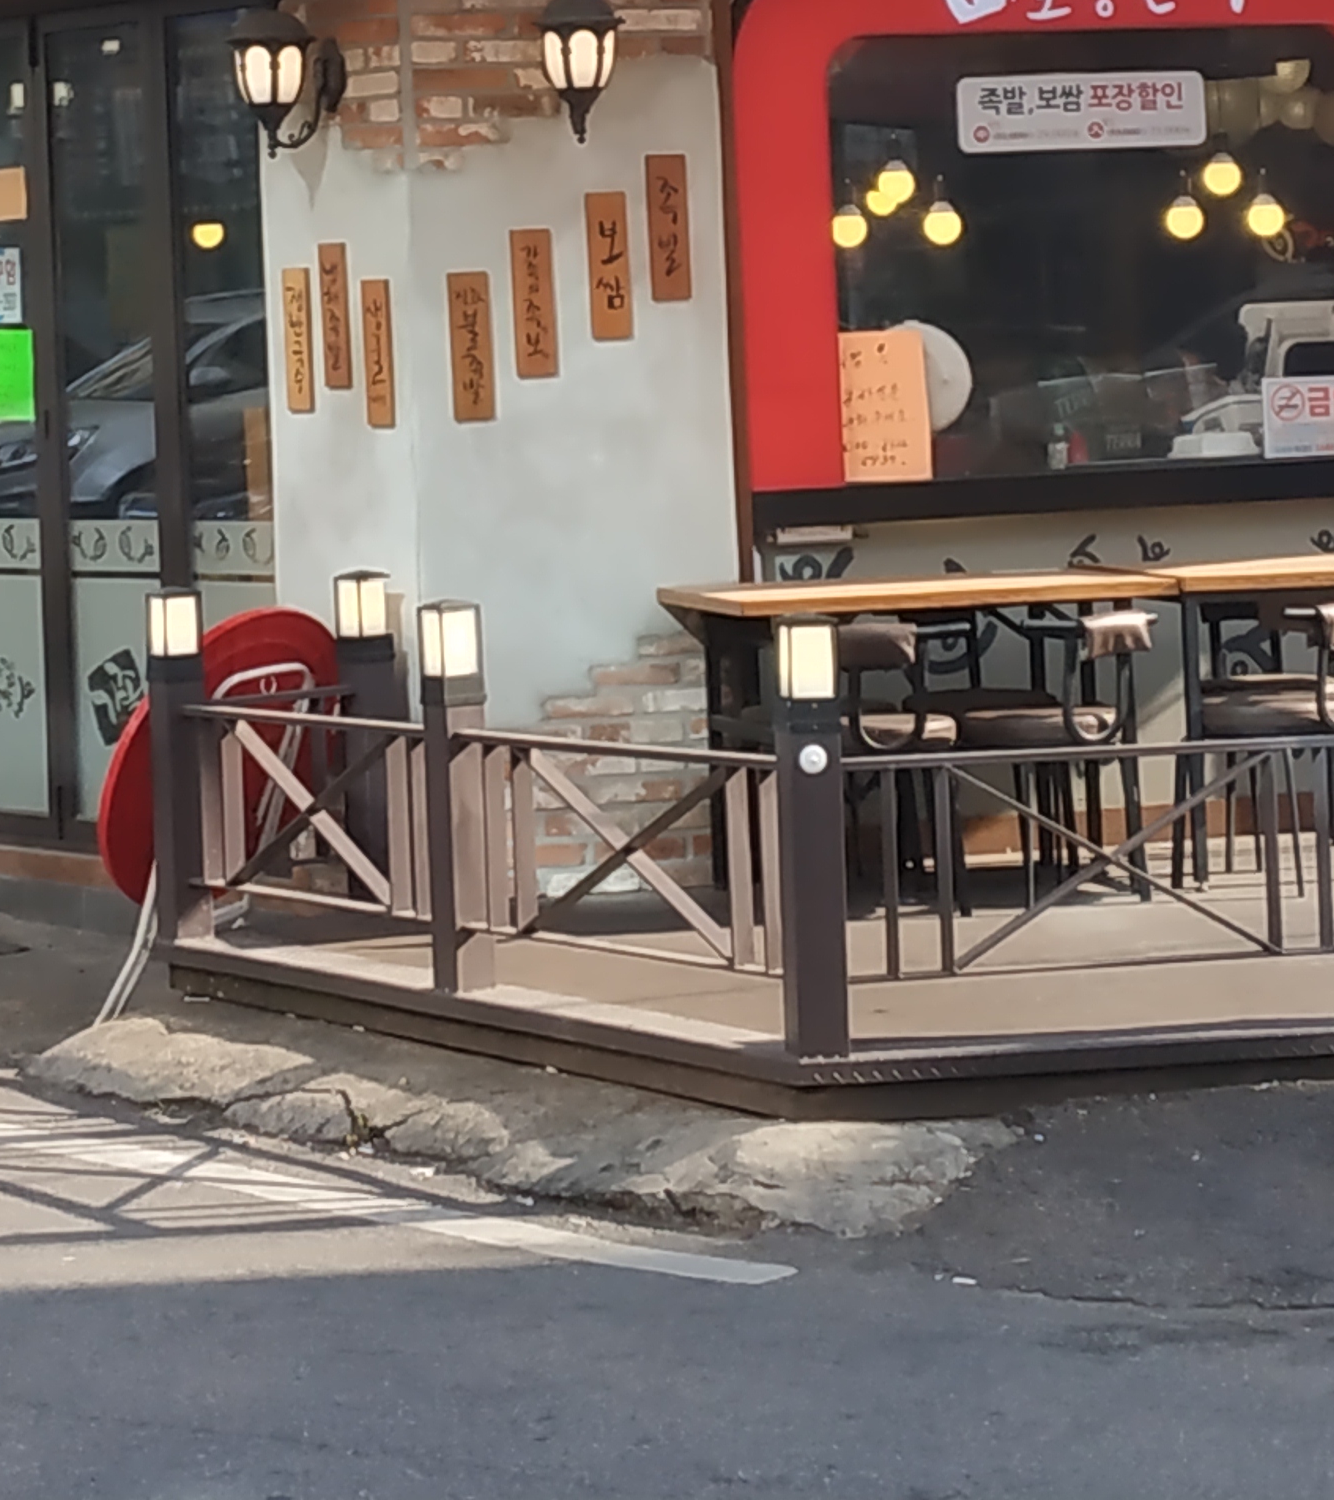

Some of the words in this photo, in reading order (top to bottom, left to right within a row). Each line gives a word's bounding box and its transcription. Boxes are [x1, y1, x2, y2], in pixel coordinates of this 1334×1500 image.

[978, 84, 1083, 116] 족발,보쌈
[1087, 81, 1184, 112] 포장할인
[596, 219, 625, 311] 보쌈
